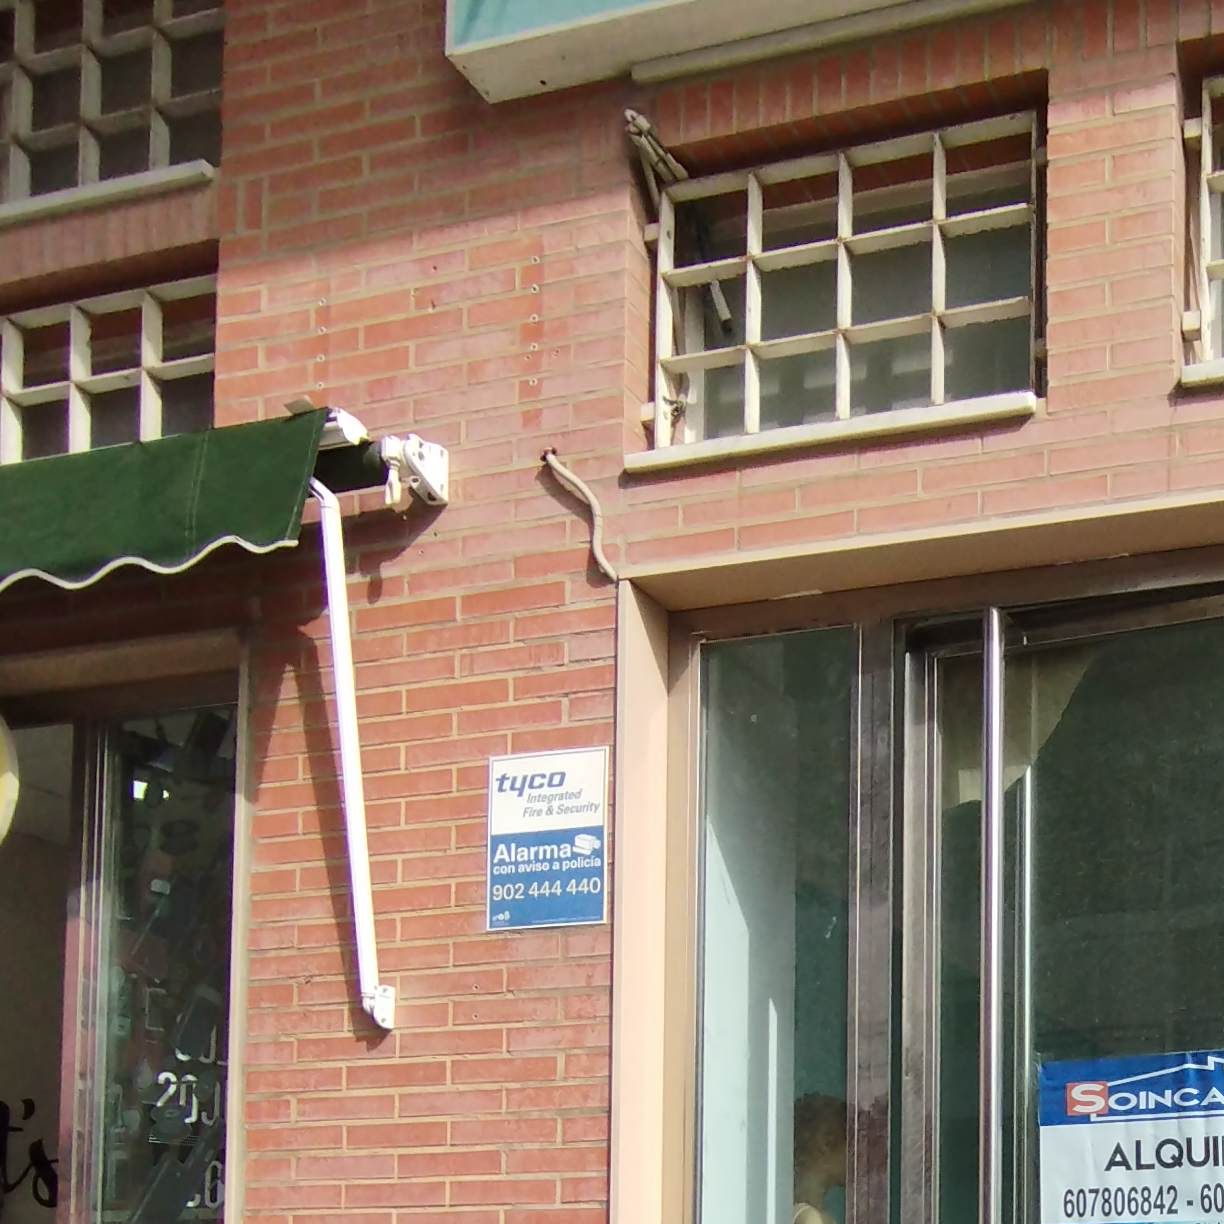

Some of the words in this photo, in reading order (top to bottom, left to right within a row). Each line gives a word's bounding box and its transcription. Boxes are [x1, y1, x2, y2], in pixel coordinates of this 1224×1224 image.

[495, 771, 567, 797] tyco
[526, 788, 583, 804] Integrated
[522, 806, 543, 818] Fire
[545, 805, 554, 816] &
[556, 802, 601, 815] Security
[493, 842, 572, 864] Alarma
[493, 864, 516, 875] con
[518, 861, 551, 873] aviso
[552, 862, 560, 871] a
[492, 882, 525, 901] 902
[528, 880, 562, 897] 444
[566, 877, 601, 895] 440
[1063, 1184, 1178, 1218] 607806842
